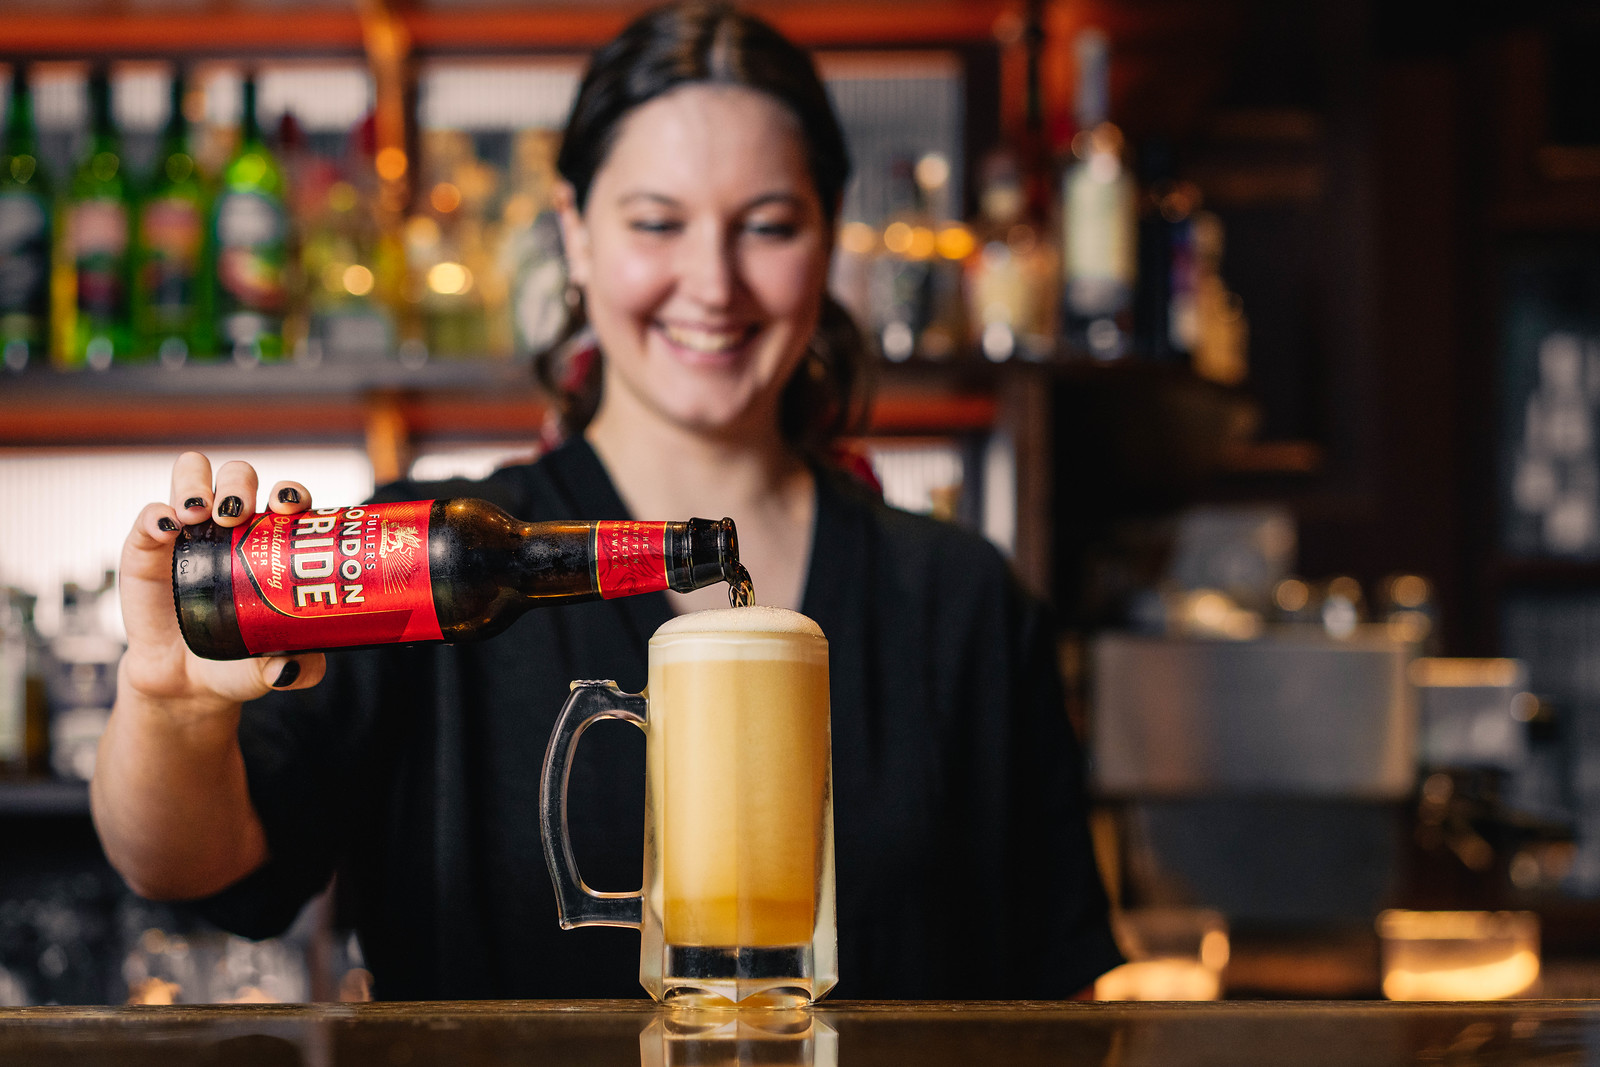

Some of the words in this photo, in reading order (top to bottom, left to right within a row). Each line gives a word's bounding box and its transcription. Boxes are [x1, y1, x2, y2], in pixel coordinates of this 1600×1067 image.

[260, 530, 269, 566] AMBER
[267, 516, 290, 590] Outstanding
[293, 507, 340, 607] PRIDE
[364, 514, 380, 570] FULLER'S
[632, 522, 640, 564] GRIFFIN
[642, 530, 650, 549] THE
